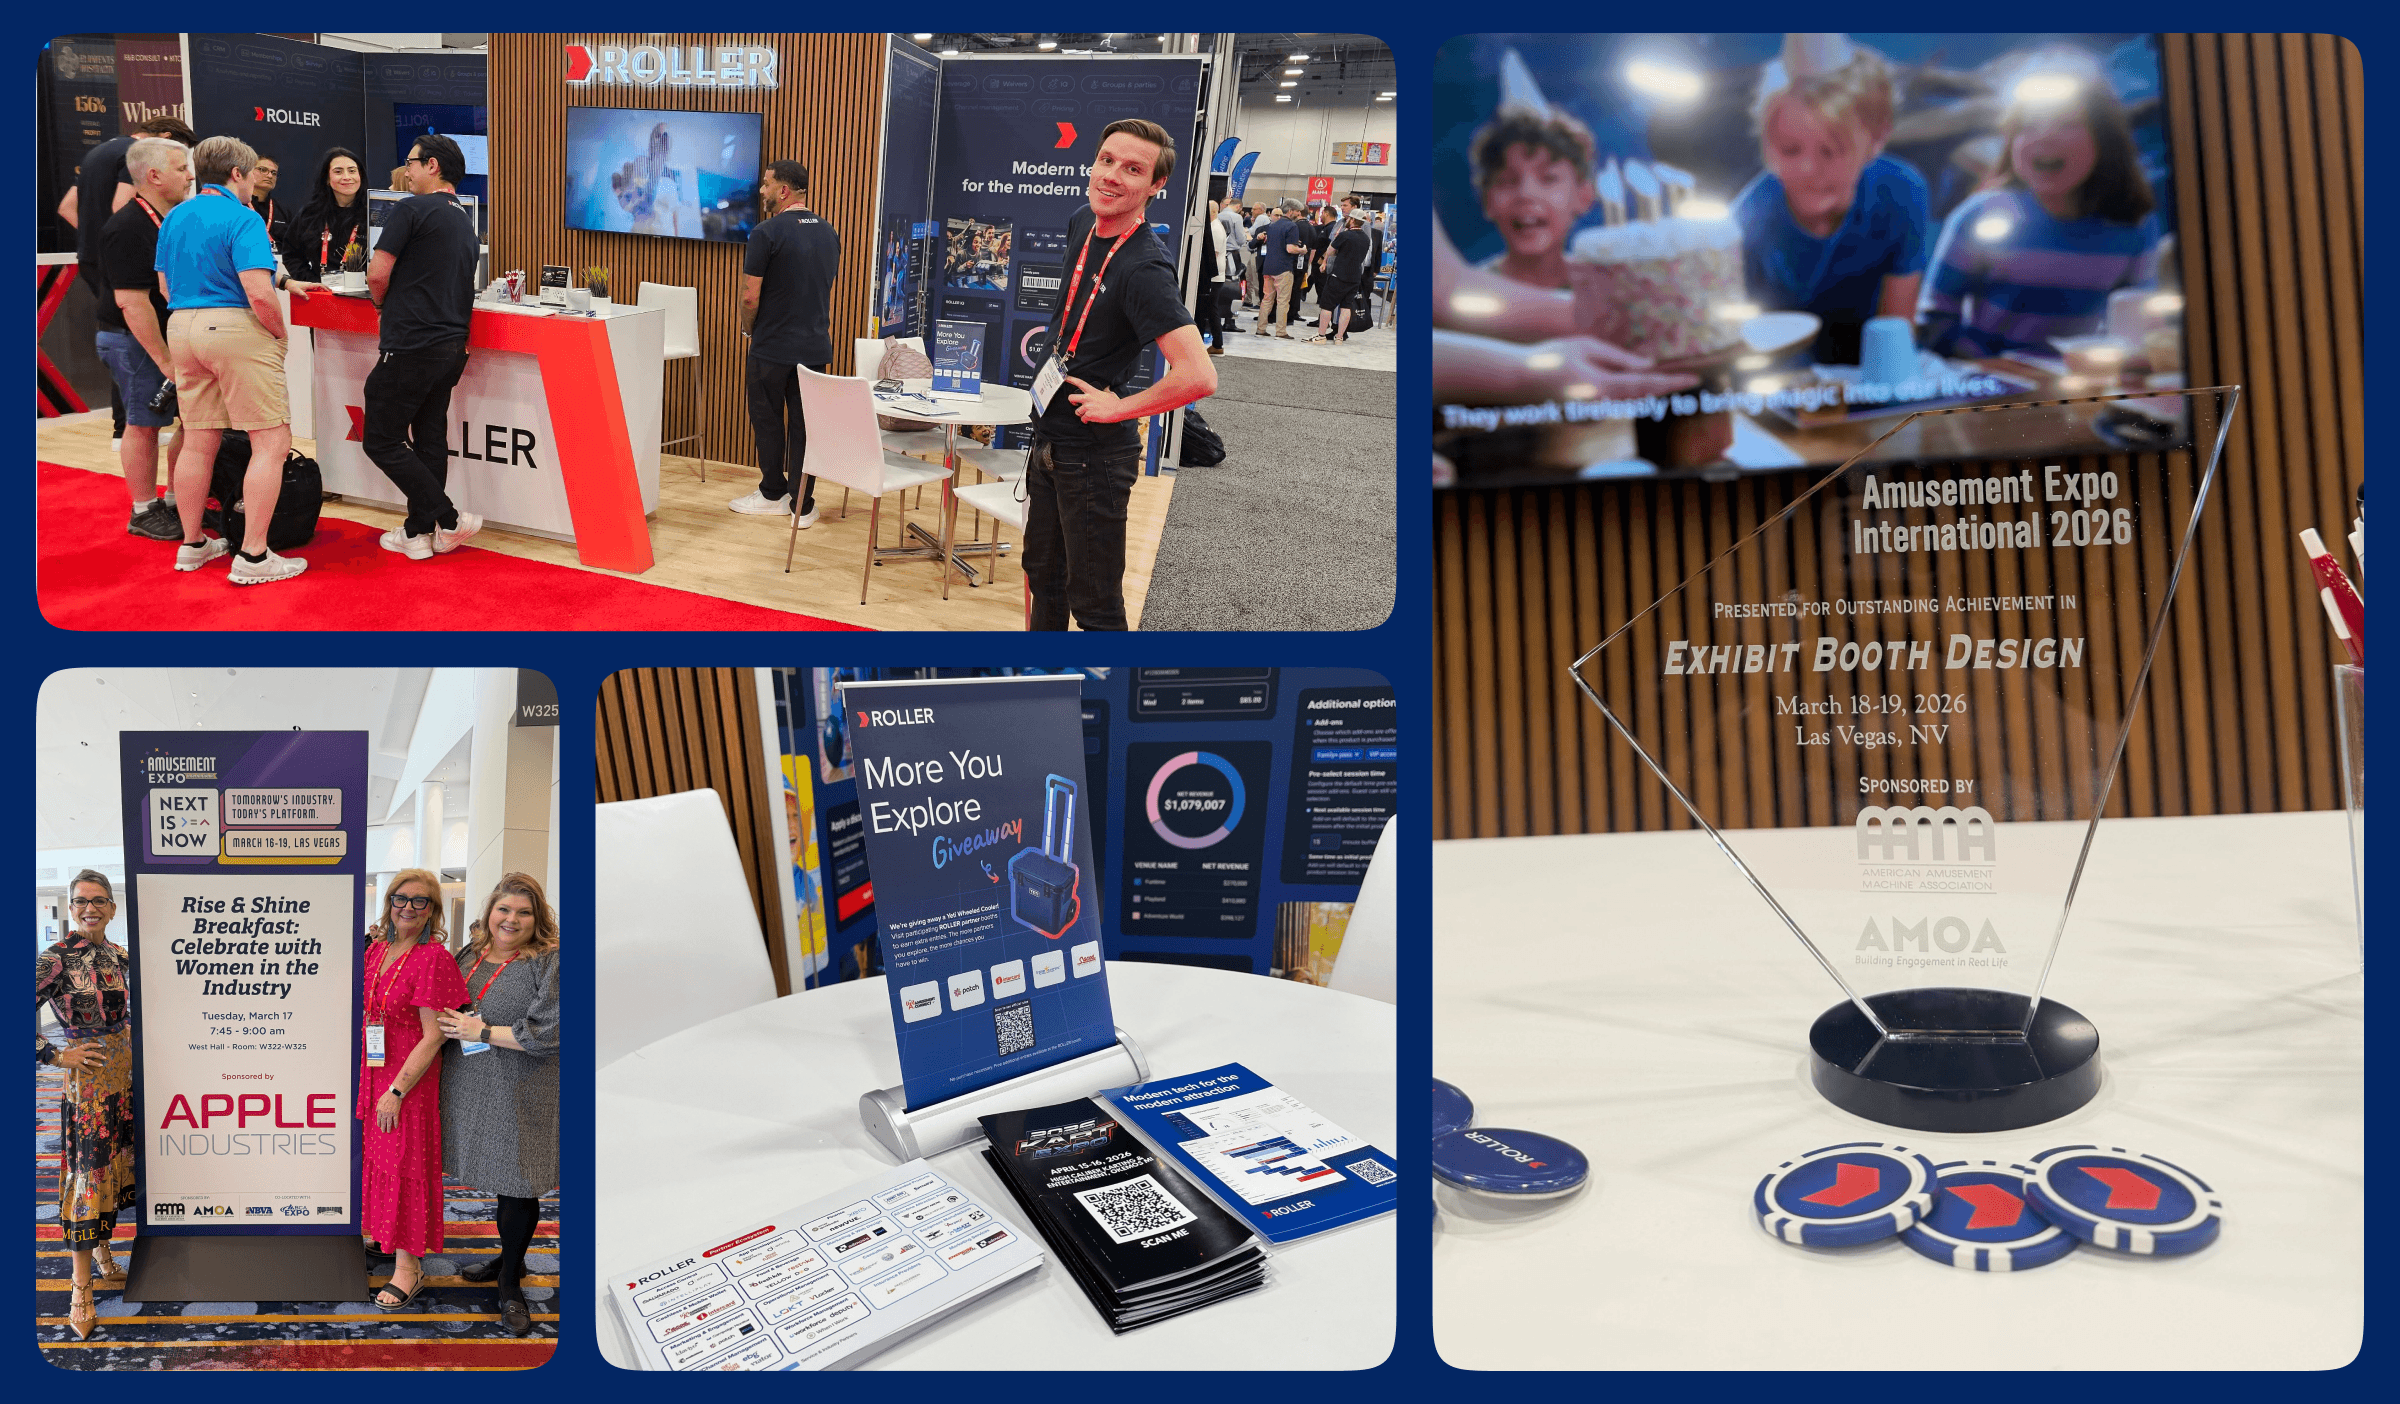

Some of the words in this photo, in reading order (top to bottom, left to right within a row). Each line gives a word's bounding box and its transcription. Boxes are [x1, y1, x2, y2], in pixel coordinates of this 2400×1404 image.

[600, 45, 777, 88] ROLLER
[1002, 80, 1028, 89] Waivers
[1102, 81, 1127, 92] Groups
[1138, 82, 1157, 92] parties
[75, 95, 106, 113] 156%
[122, 101, 166, 123] What
[266, 108, 320, 127] ROLLER
[1012, 161, 1075, 177] Modern
[962, 179, 985, 193] for
[988, 180, 1013, 194] the
[1017, 182, 1081, 198] modern
[1442, 404, 1499, 432] They
[1503, 401, 1562, 425] work
[1670, 393, 1698, 416] to
[1700, 389, 1765, 415] bring
[1766, 384, 1840, 412] magic
[1843, 380, 1892, 403] into
[1863, 469, 2033, 510] Amusement
[2045, 465, 2118, 508] Expo
[1854, 511, 2040, 554] International
[2052, 508, 2132, 547] 2026
[1836, 597, 1939, 616] OUTSTANDING
[1946, 595, 2054, 613] ACHIEVEMENT
[1664, 639, 1800, 676] EXHIBIT
[1813, 636, 1932, 672] BOOTH
[1945, 632, 2085, 670] DESIGN
[522, 704, 559, 718] W325
[1307, 699, 1361, 709] Additional
[1777, 695, 1842, 716] March
[1850, 694, 1906, 717] 18-19,
[1916, 693, 1966, 714] 2026
[871, 708, 935, 727] ROLLER
[1796, 725, 1830, 746] Las
[1837, 724, 1902, 750] Vegas,
[1911, 724, 1949, 745] NV
[148, 757, 216, 772] AMUSEMENT
[864, 756, 943, 790] More
[949, 750, 1003, 780] You
[148, 773, 186, 784] EXPO
[1859, 776, 1949, 794] SPONSORED
[1955, 779, 1974, 794] BY
[160, 796, 208, 811] NEXT
[232, 794, 289, 805] TOMORROW'S
[292, 795, 336, 805] INDUSTRY.
[1164, 799, 1226, 812] $1,079,007
[160, 815, 176, 830] IS
[232, 808, 267, 819] TODAY'S
[271, 809, 319, 819] PLATFORM.
[870, 796, 981, 837] Explore
[161, 833, 207, 848] NOW
[233, 838, 262, 848] MARCH
[265, 838, 291, 849] 16-19,
[294, 838, 310, 848] LAS
[313, 838, 340, 848] VEGAS
[933, 818, 1022, 869] Giveaway
[1862, 868, 1920, 877] AMERICAN
[1926, 869, 1993, 878] AMUSEMENT
[1862, 880, 1913, 889] MACHINE
[1919, 881, 1993, 891] ASSOCIATION
[181, 896, 225, 913] Rise
[231, 897, 245, 913] &
[251, 896, 310, 913] Shine
[891, 932, 905, 940] Visit
[905, 926, 938, 939] participating
[939, 920, 961, 930] ROLLER
[961, 918, 980, 927] partner
[980, 913, 998, 922] booths
[909, 919, 926, 928] giving
[927, 915, 941, 924] away
[946, 911, 956, 919] Yeti
[957, 907, 980, 916] Wheeled
[193, 917, 300, 938] Breakfast:
[1855, 915, 2007, 953] AMOA
[171, 938, 269, 955] Celebrate
[275, 938, 322, 955] with
[176, 959, 254, 975] Women
[260, 959, 280, 975] in
[286, 958, 319, 975] the
[1855, 955, 1893, 967] Building
[1896, 956, 1955, 968] Engagement
[1957, 957, 1965, 966] in
[1968, 957, 1989, 967] Real
[1992, 957, 2008, 969] Life
[202, 979, 291, 999] Industry
[962, 984, 980, 994] patch
[202, 1012, 246, 1021] Tuesday,
[249, 1012, 280, 1020] March
[282, 1012, 293, 1020] 17
[210, 1027, 232, 1035] 7:45
[242, 1027, 266, 1035] 9:00
[221, 1073, 263, 1081] Sponsored
[265, 1073, 274, 1081] by
[1122, 1089, 1173, 1103] Modern
[1171, 1083, 1200, 1094] tech
[1199, 1079, 1217, 1088] for
[1217, 1074, 1239, 1083] the
[1133, 1097, 1183, 1111] modern
[1183, 1083, 1240, 1102] attraction
[160, 1093, 336, 1129] APPLE
[160, 1133, 336, 1156] INDUSTRIES
[1018, 1122, 1116, 1154] KART
[1034, 1136, 1108, 1159] EXPO
[1464, 1131, 1535, 1163] ROLLER
[1046, 1171, 1111, 1189] ENTERTAINMENT,
[1110, 1160, 1144, 1174] OKEMOS
[1144, 1156, 1154, 1165] MI
[1049, 1174, 1071, 1183] HIGH
[1070, 1168, 1103, 1179] CALIBER
[1101, 1158, 1137, 1172] KARTING
[1050, 1165, 1079, 1176] APRIL
[1078, 1159, 1106, 1170] 15-16,
[1105, 1151, 1132, 1163] 2026
[193, 1205, 234, 1216] AMOA
[1270, 1200, 1316, 1217] ROLLER
[709, 1242, 734, 1255] Partner
[735, 1228, 769, 1244] Ecosystem
[1140, 1234, 1173, 1249] SCAN
[1170, 1228, 1190, 1241] ME
[638, 1257, 696, 1285] ROLLER
[813, 1298, 849, 1316] Management
[829, 1304, 854, 1318] deputy
